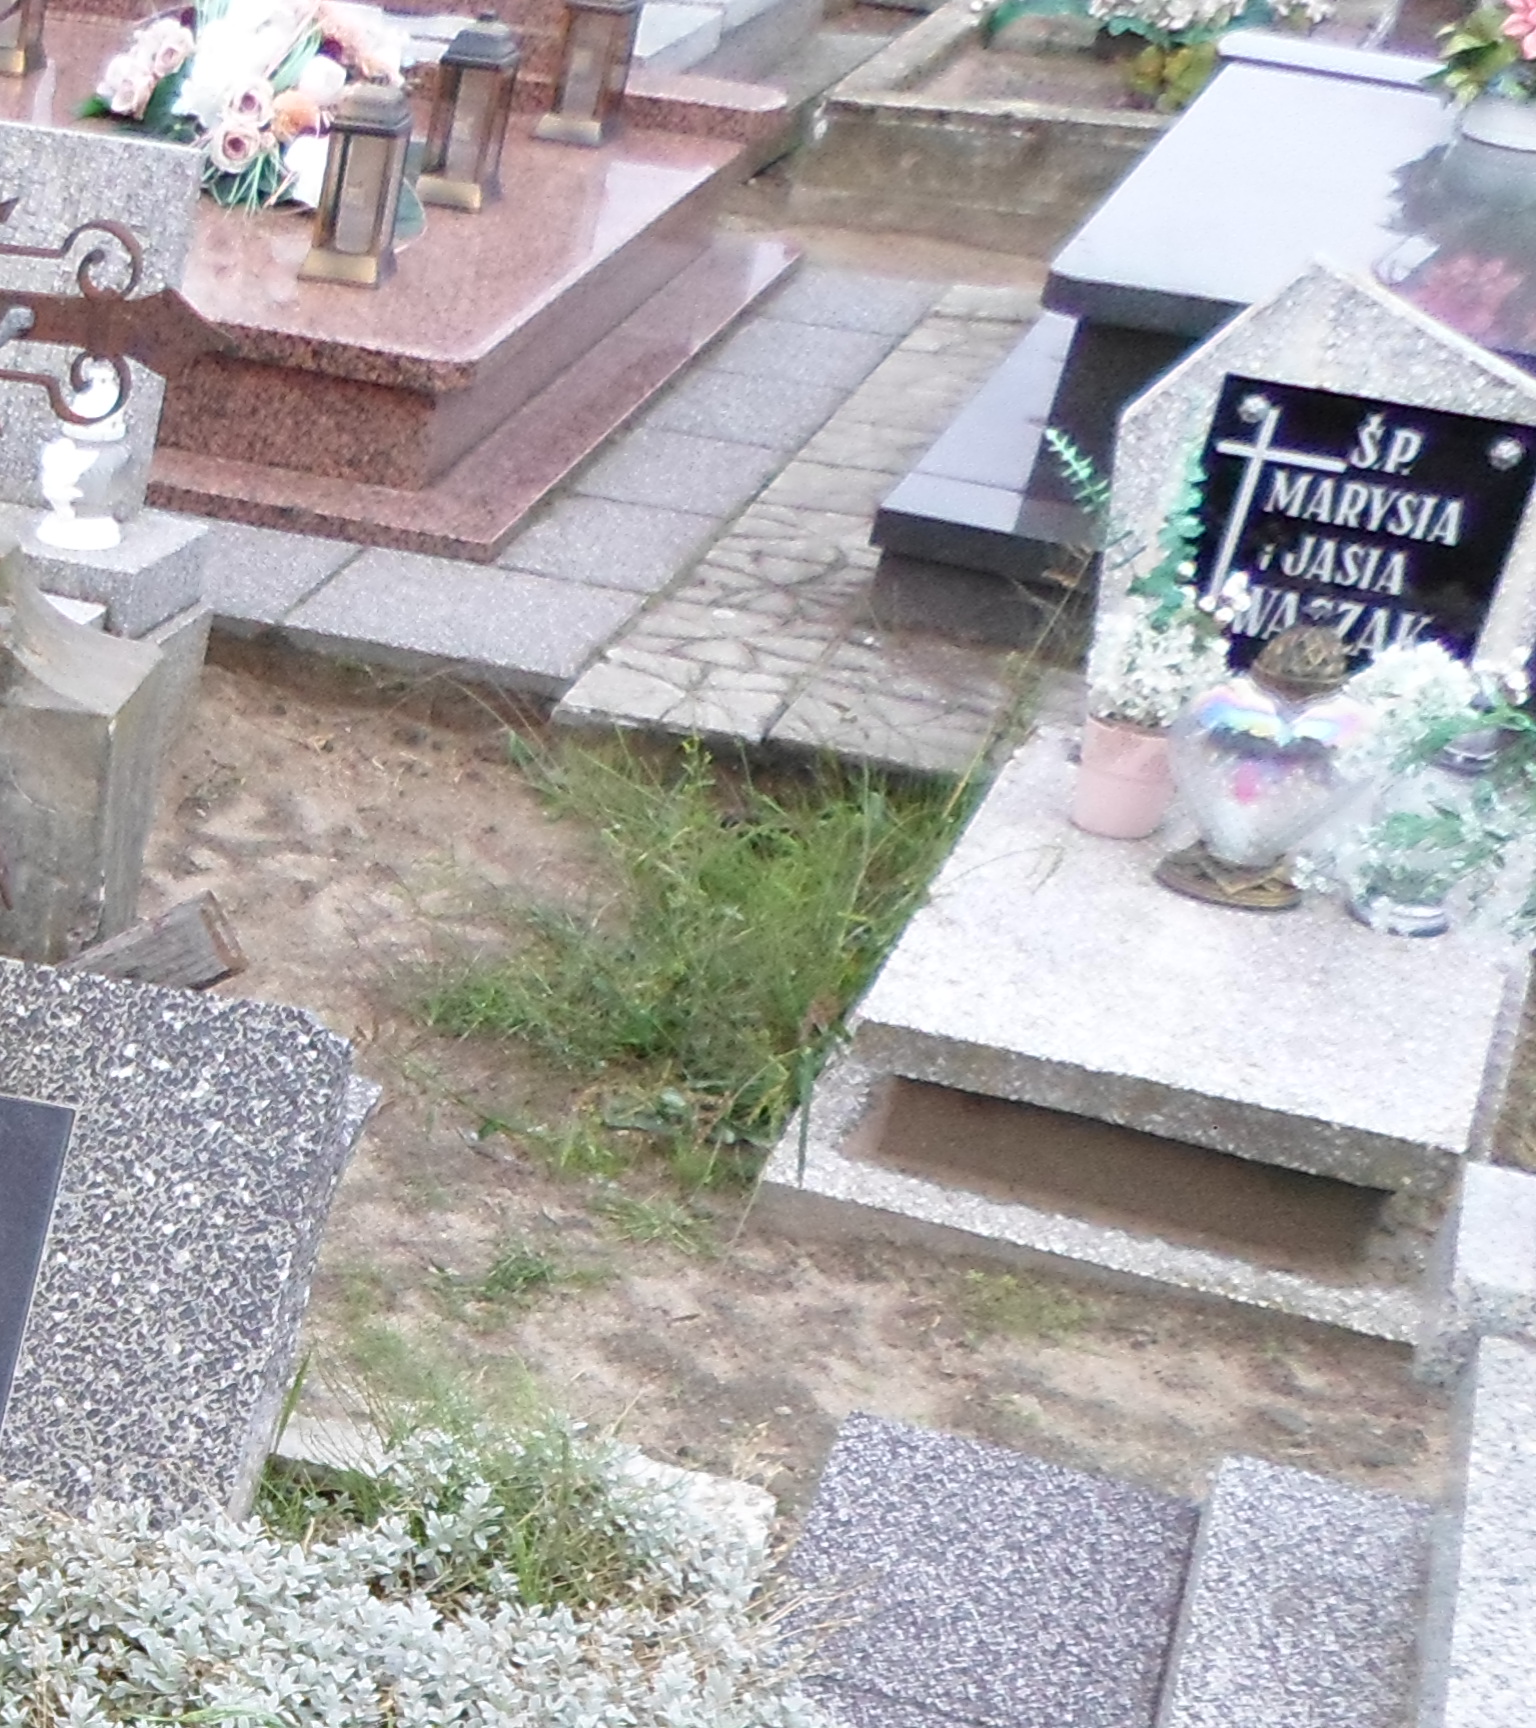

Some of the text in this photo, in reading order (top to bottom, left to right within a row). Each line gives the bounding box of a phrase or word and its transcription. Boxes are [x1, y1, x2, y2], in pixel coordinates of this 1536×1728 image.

[1262, 469, 1465, 547] MARYSIA
[1259, 535, 1407, 596] i JASIA
